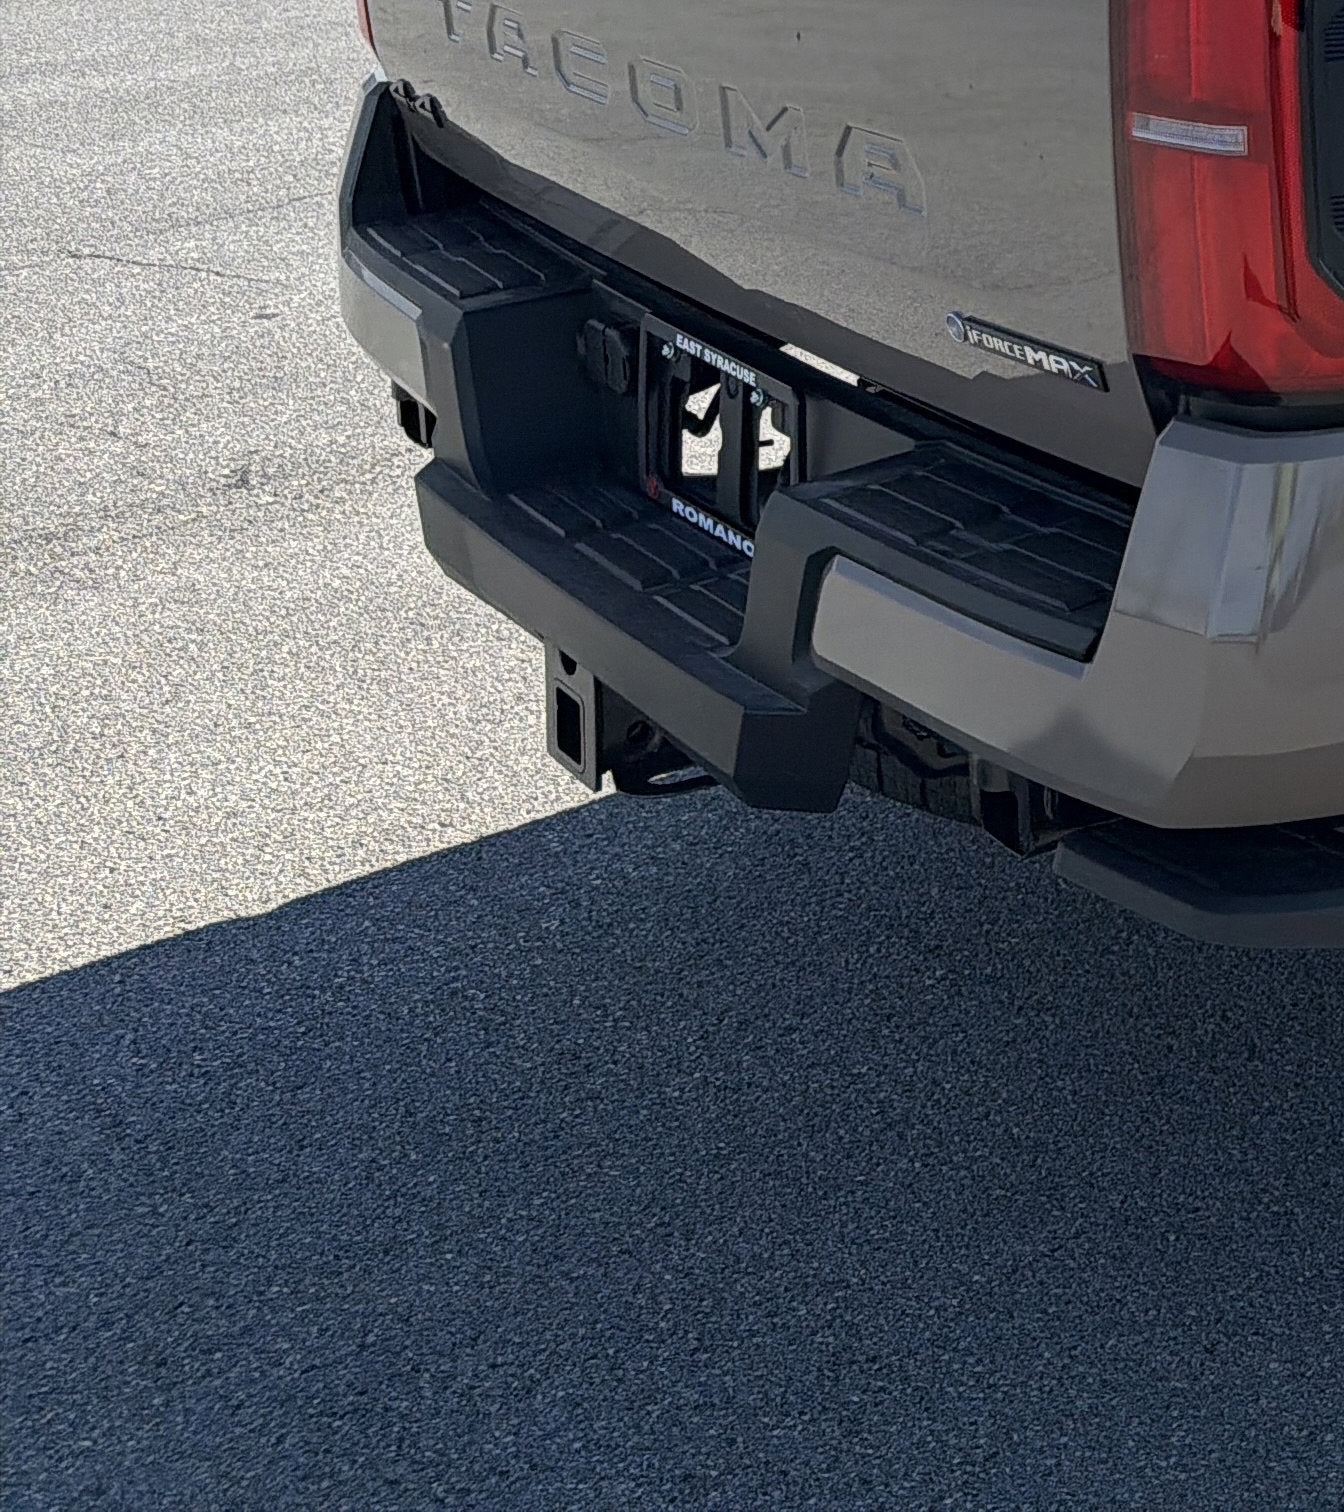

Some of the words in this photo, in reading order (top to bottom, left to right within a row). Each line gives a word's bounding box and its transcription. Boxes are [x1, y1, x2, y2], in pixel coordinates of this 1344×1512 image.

[675, 333, 702, 358] EAST
[703, 348, 757, 387] SYRACUSE
[671, 497, 755, 558] ROMANO
